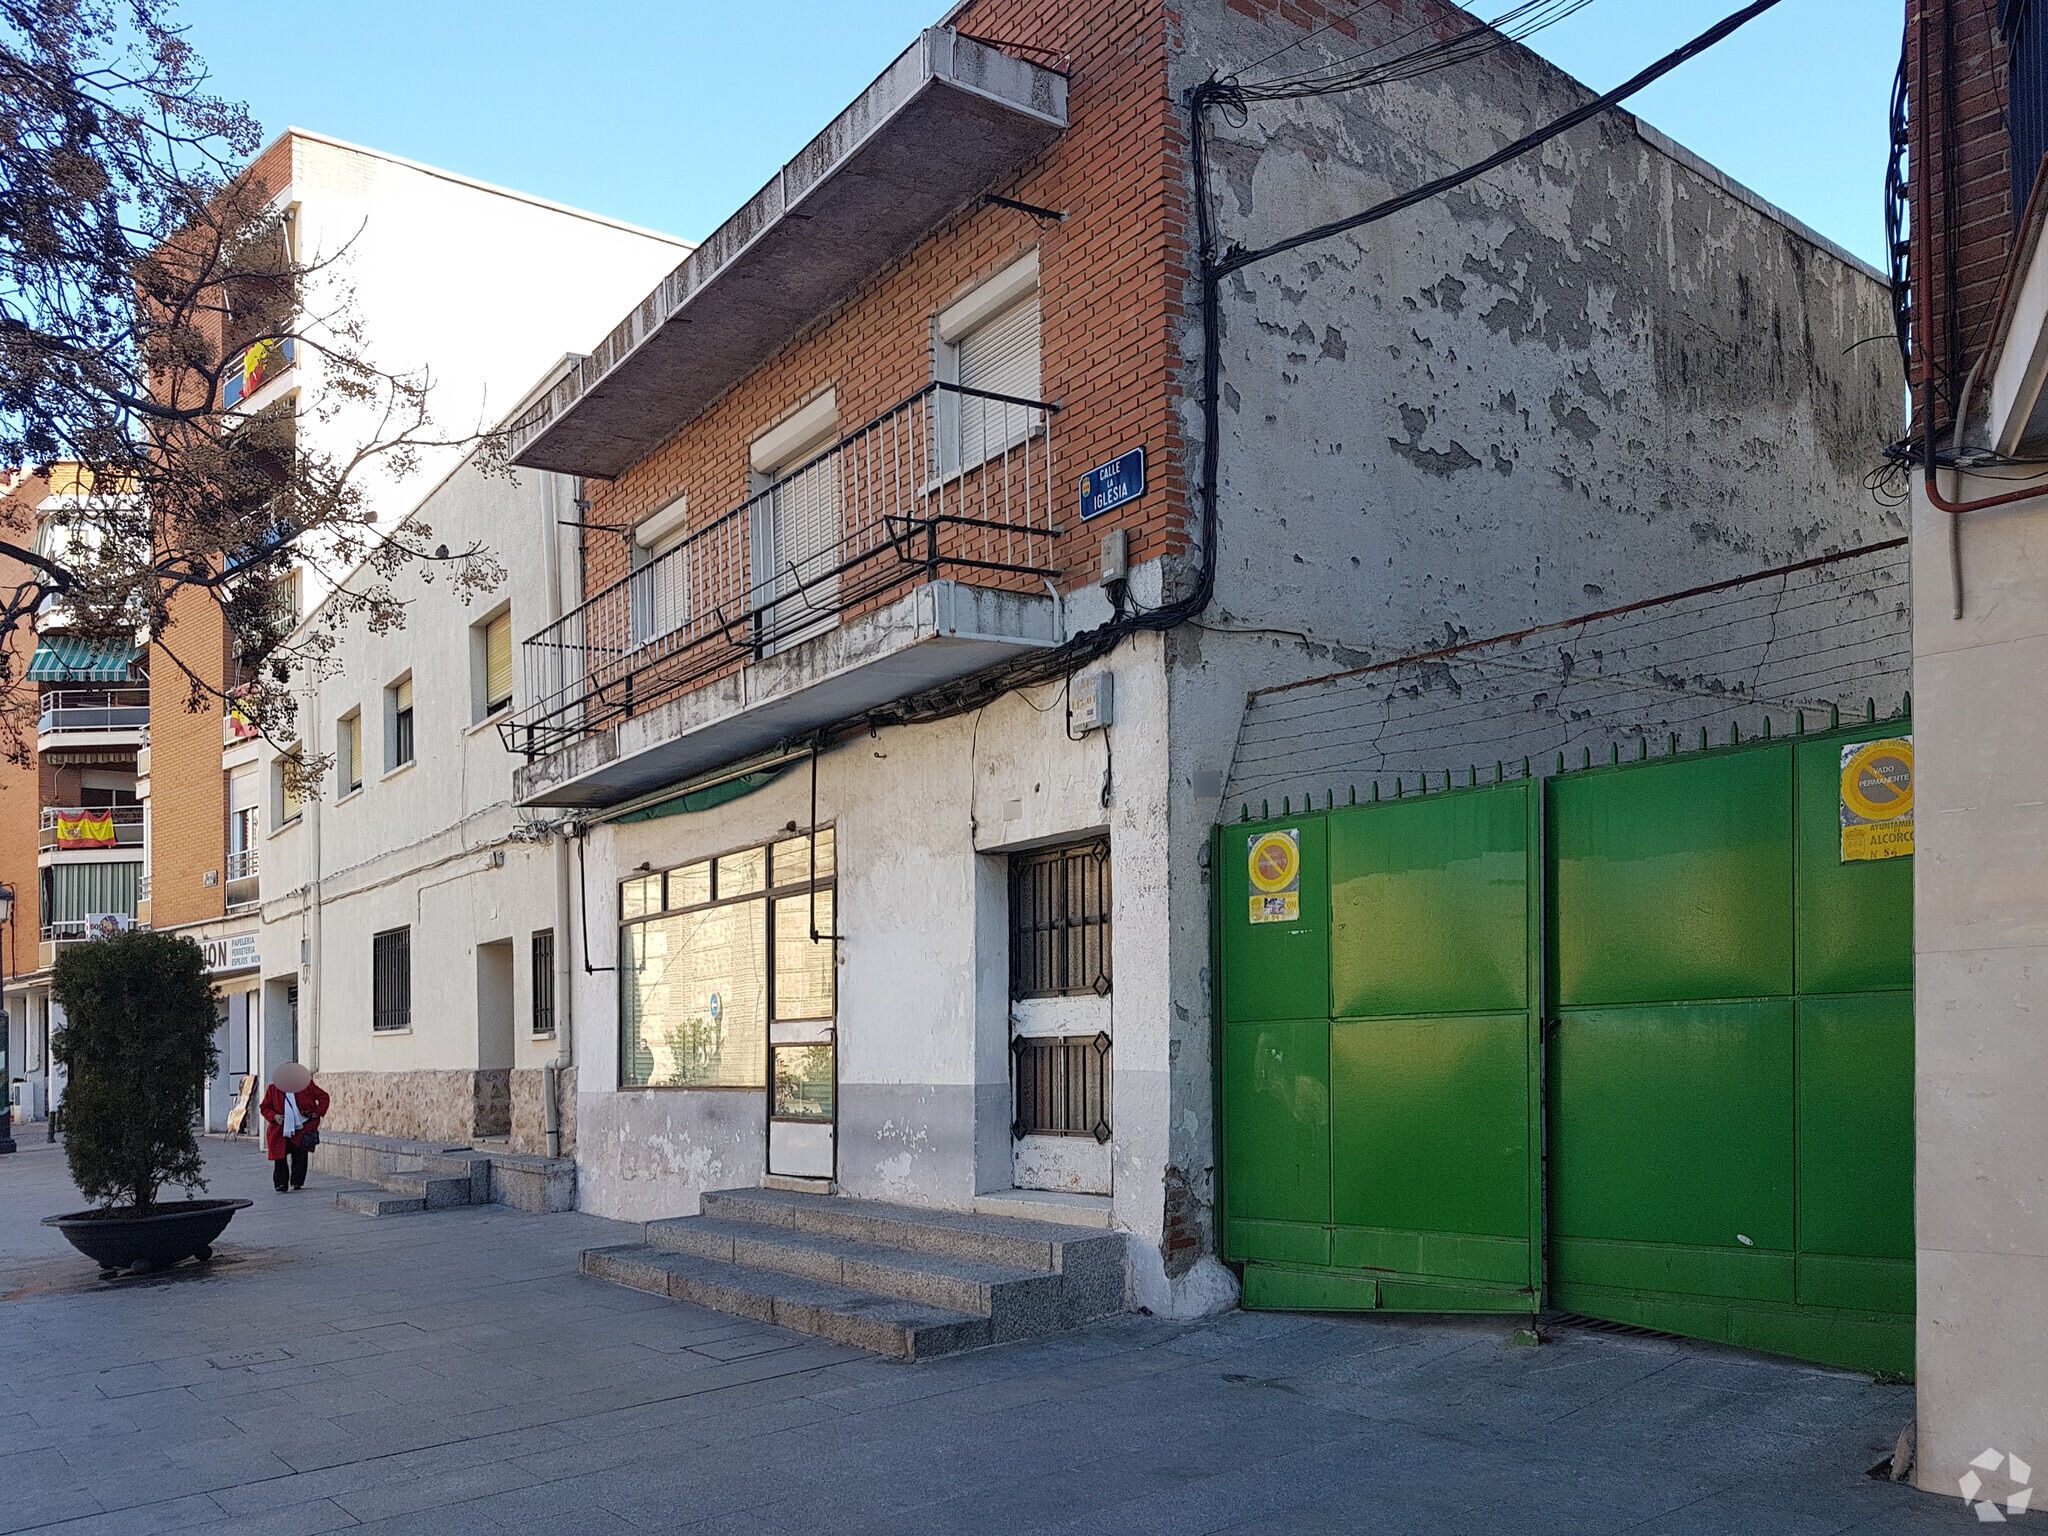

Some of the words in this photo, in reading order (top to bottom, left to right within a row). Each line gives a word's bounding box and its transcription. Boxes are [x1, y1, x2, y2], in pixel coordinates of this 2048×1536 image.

[1100, 461, 1120, 480] CALLE
[1107, 479, 1113, 488] LA
[1094, 482, 1128, 510] IGLESIA
[1873, 765, 1894, 774] VADO
[1859, 774, 1909, 787] PERMANENTE
[232, 936, 255, 947] PAPELERIA
[232, 956, 248, 966] ESPEJOS
